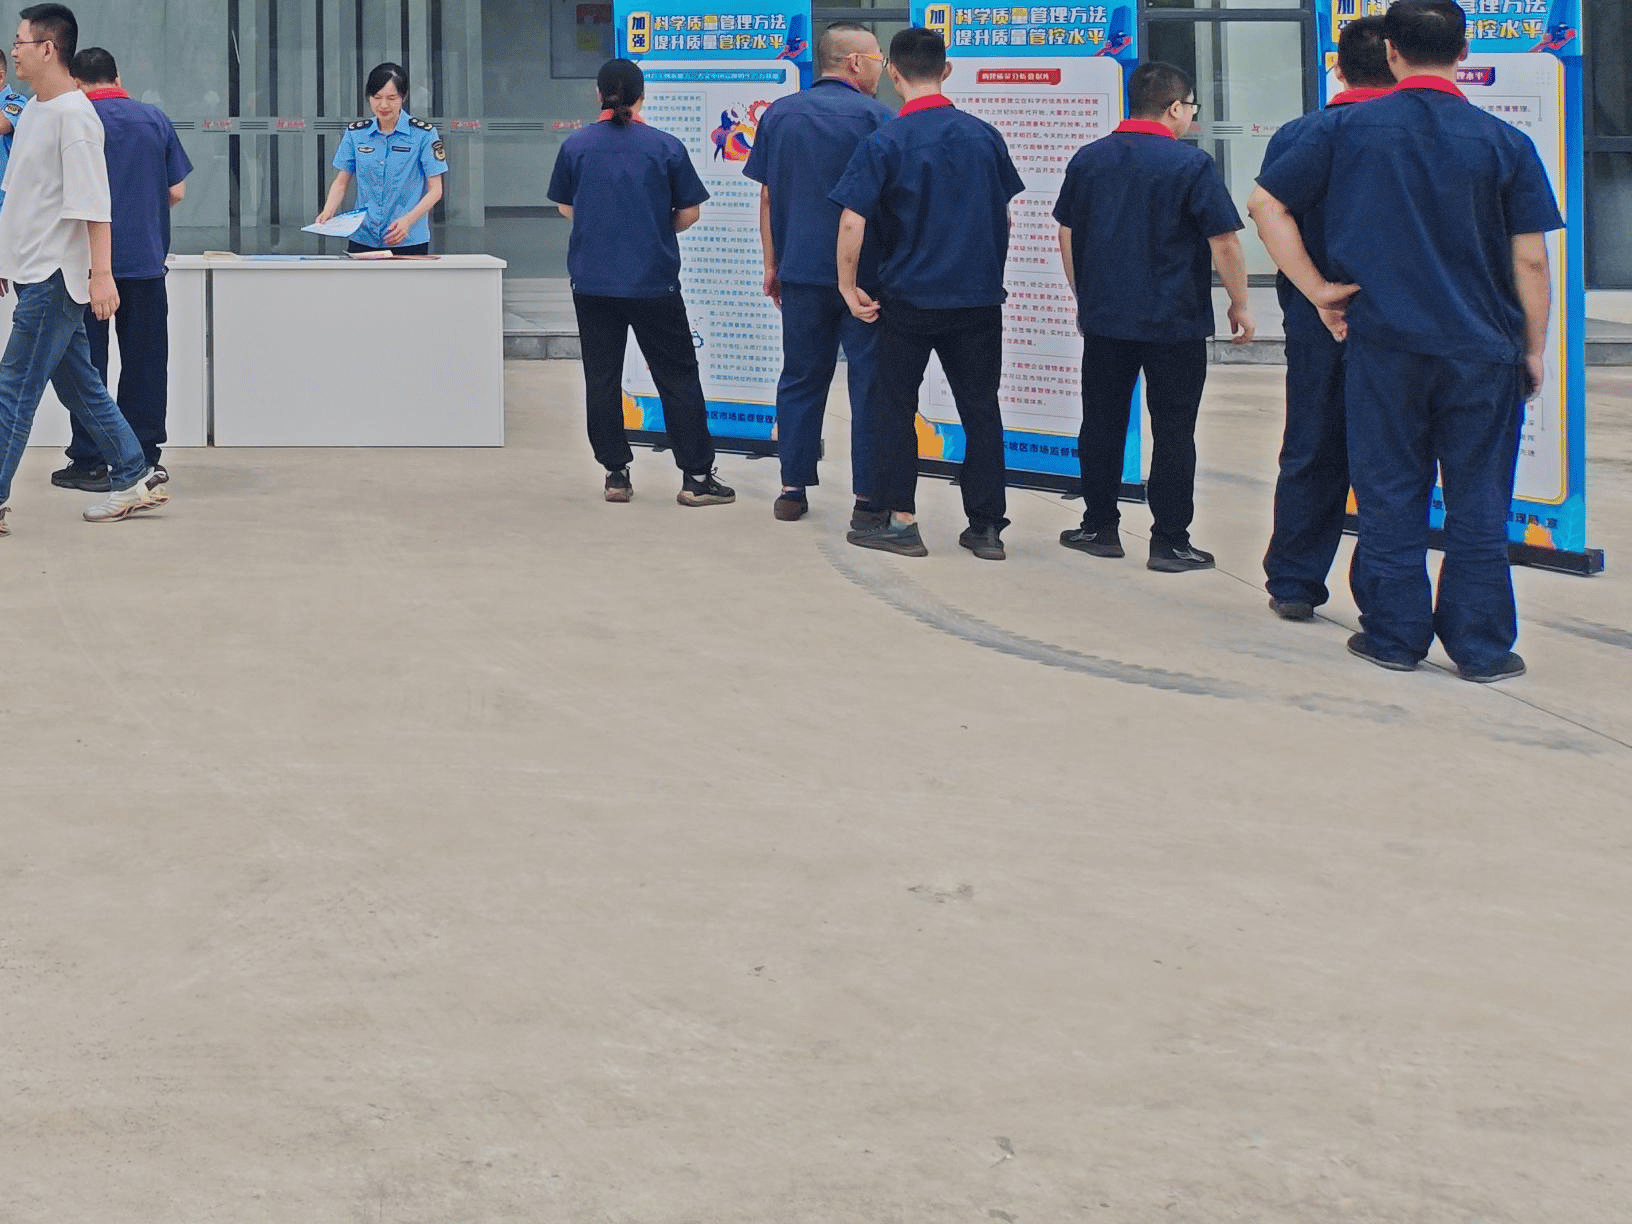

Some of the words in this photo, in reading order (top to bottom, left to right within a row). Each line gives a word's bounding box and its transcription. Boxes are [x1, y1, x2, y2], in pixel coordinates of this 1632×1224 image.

[654, 13, 786, 32] 科学质量管理方法
[955, 5, 1108, 26] 科学质量管理方法
[631, 16, 646, 48] 加强
[654, 33, 785, 50] 提升质量管控水平
[955, 28, 1106, 46] 提升质量管控水平
